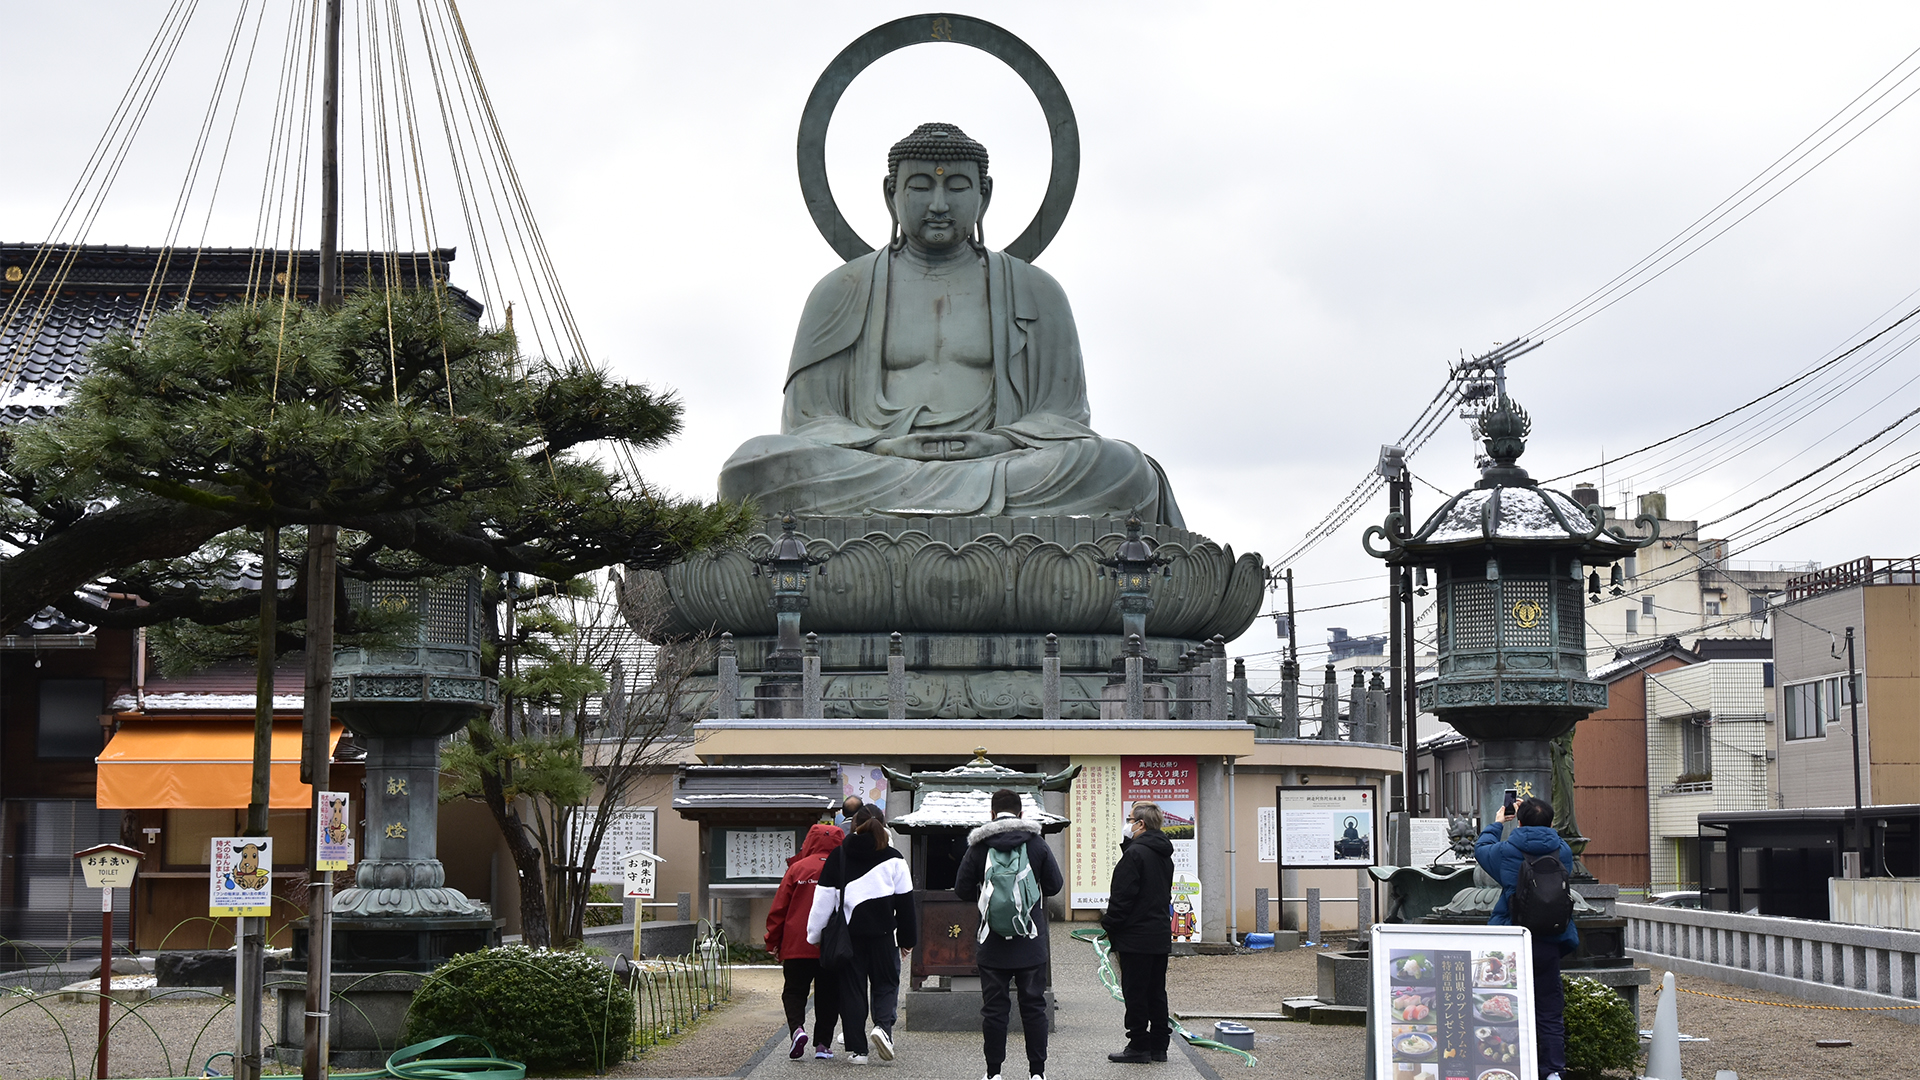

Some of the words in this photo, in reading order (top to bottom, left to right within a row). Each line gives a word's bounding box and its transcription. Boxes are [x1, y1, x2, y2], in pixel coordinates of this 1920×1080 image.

[88, 856, 129, 866] お手洗い
[223, 840, 231, 872] 犬のふんは
[628, 859, 638, 881] お守
[641, 860, 652, 885] 御朱印
[1442, 960, 1455, 1049] 特産品をプレゼント
[1455, 961, 1467, 1058] 富山県のプレミアムな
